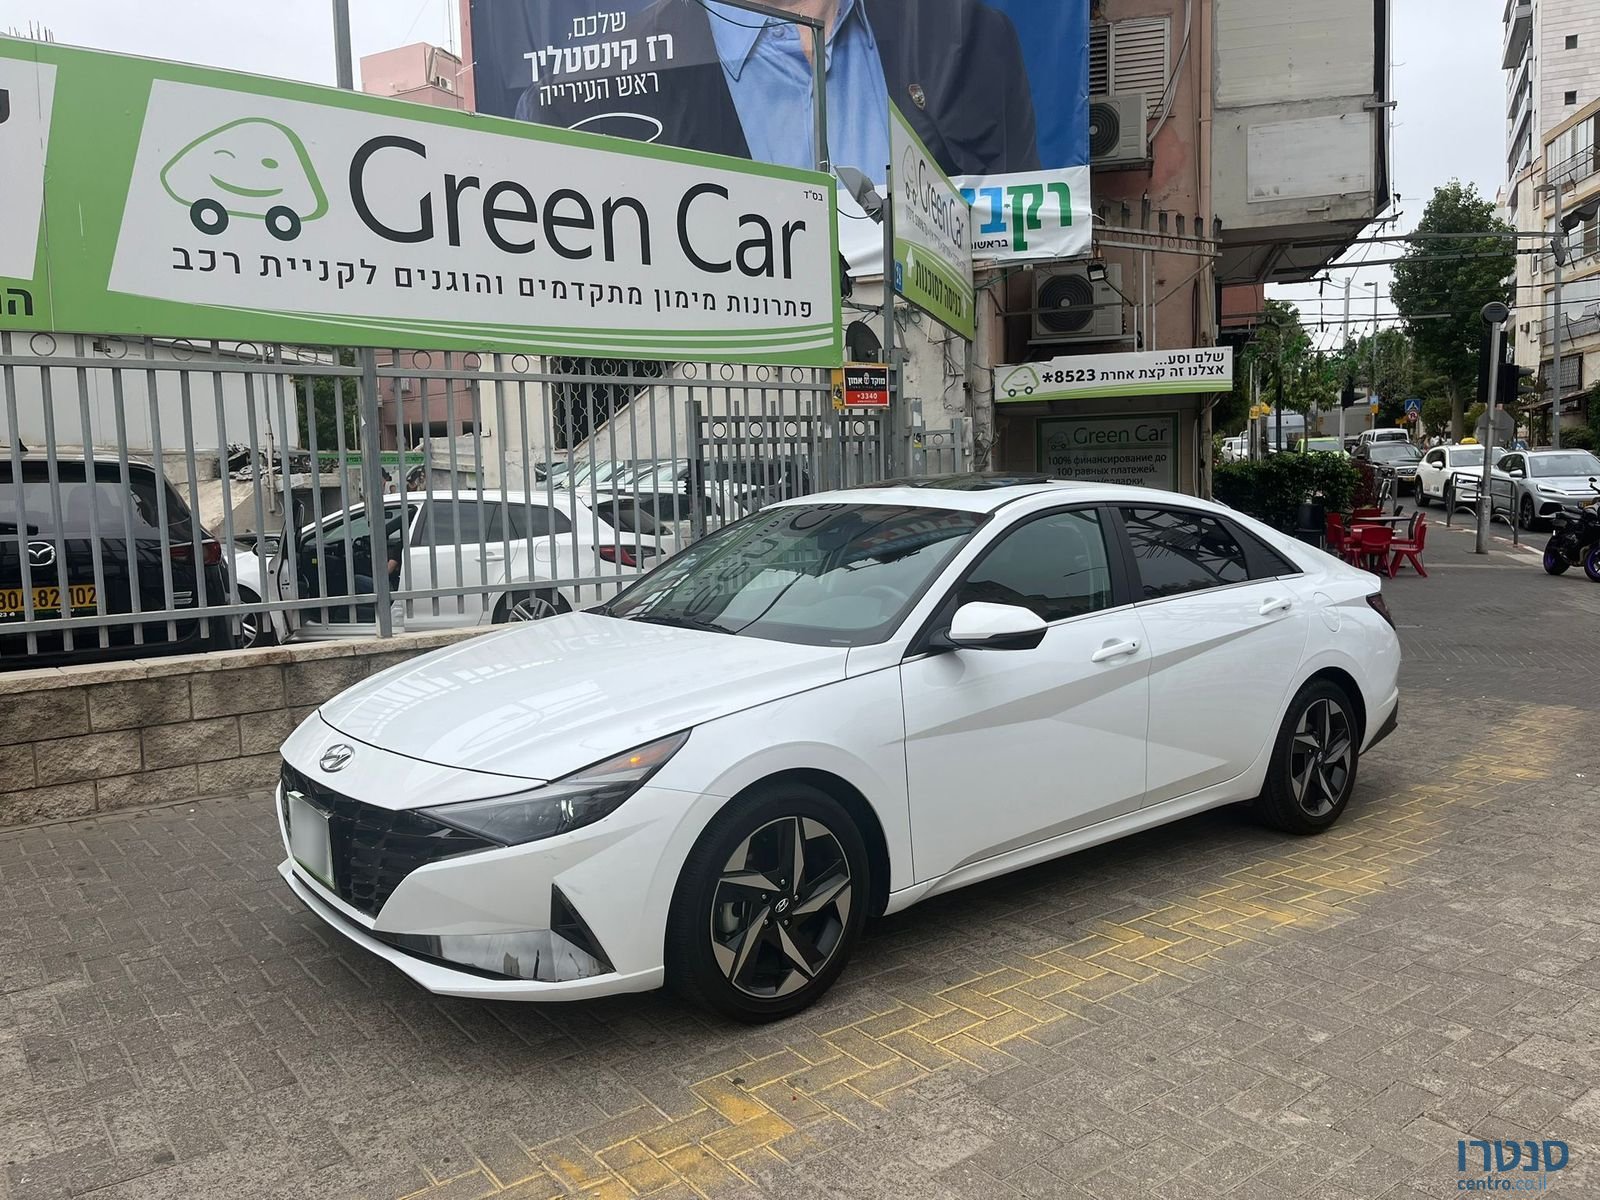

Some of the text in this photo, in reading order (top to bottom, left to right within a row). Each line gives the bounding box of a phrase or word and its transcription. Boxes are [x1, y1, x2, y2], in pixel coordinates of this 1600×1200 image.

[568, 11, 626, 39] שלכם,
[524, 34, 674, 82] רז קינסטליך
[540, 72, 659, 106] ראש העירייה
[803, 190, 823, 201] בס"ד
[349, 135, 651, 266] Green
[677, 182, 806, 279] Car
[918, 159, 965, 249] Green Car
[970, 238, 1009, 250] בראשו
[172, 247, 812, 318] פתרונות מימון מתקדמים והוגנים לקניית רכב
[1154, 352, 1224, 366] שלם וסע...
[1100, 369, 1135, 381] אחרת
[1138, 368, 1166, 380] קצת
[1169, 367, 1185, 377] זה
[1188, 364, 1224, 377] אצלנו
[1073, 424, 1168, 444] Green Car
[1047, 454, 1167, 467] 100% финансирование до
[1057, 467, 1073, 476] 100
[1074, 468, 1109, 478] равных
